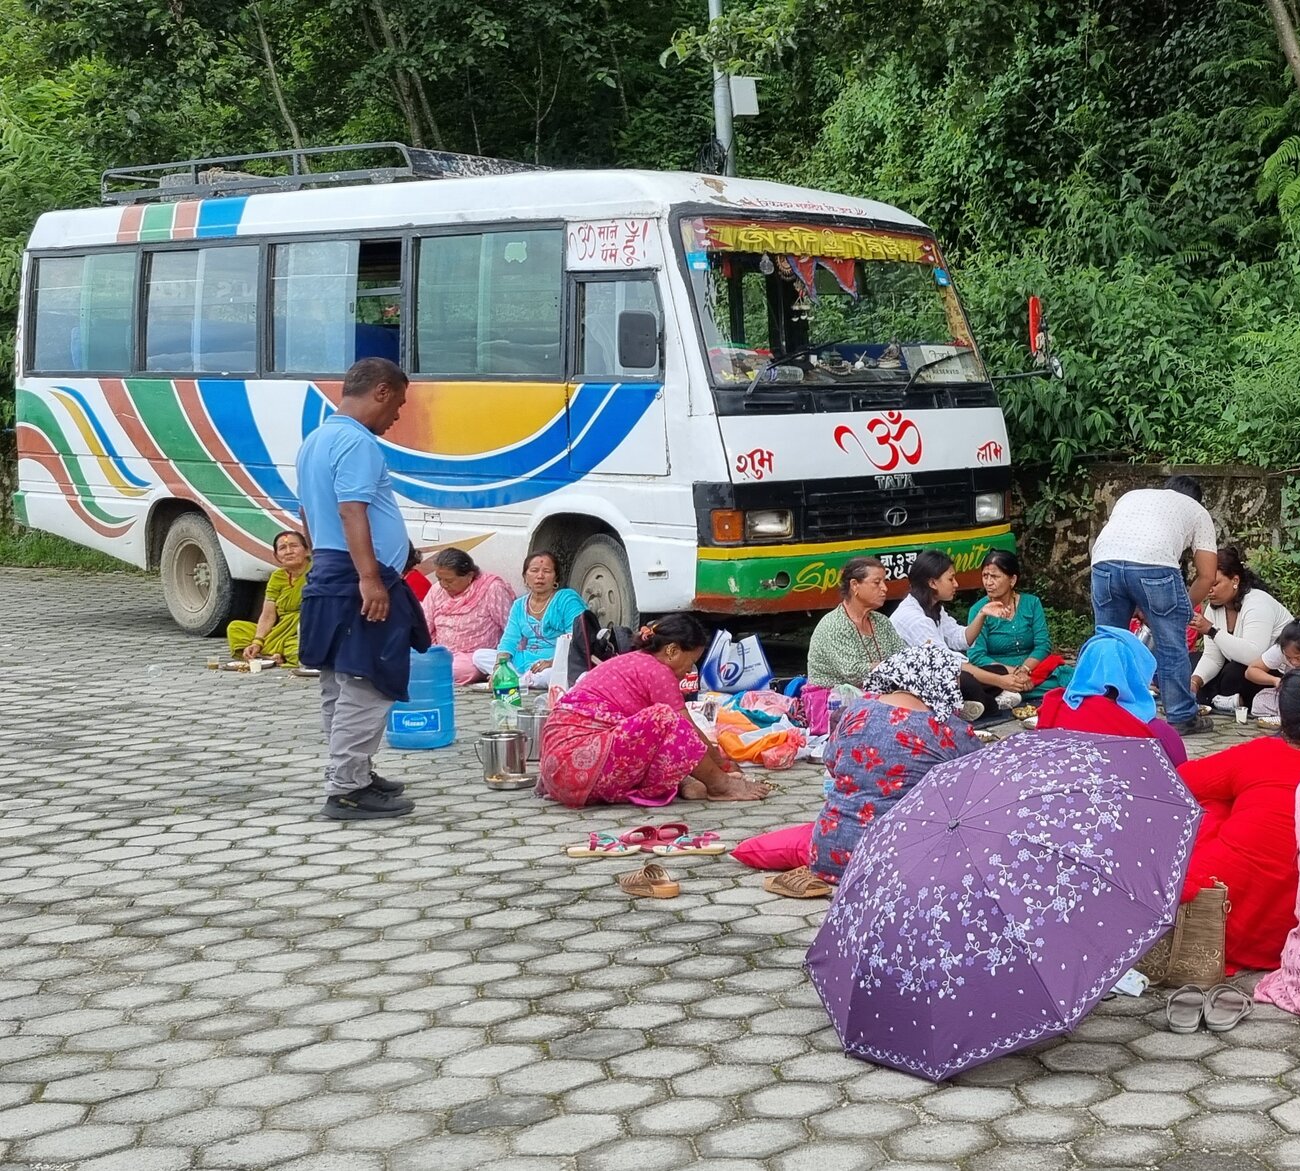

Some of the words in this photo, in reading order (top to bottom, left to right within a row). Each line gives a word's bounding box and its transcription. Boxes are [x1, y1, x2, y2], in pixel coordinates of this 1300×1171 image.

[736, 448, 774, 480] शुभ
[976, 441, 1003, 464] लाभ
[875, 474, 915, 490] TATA
